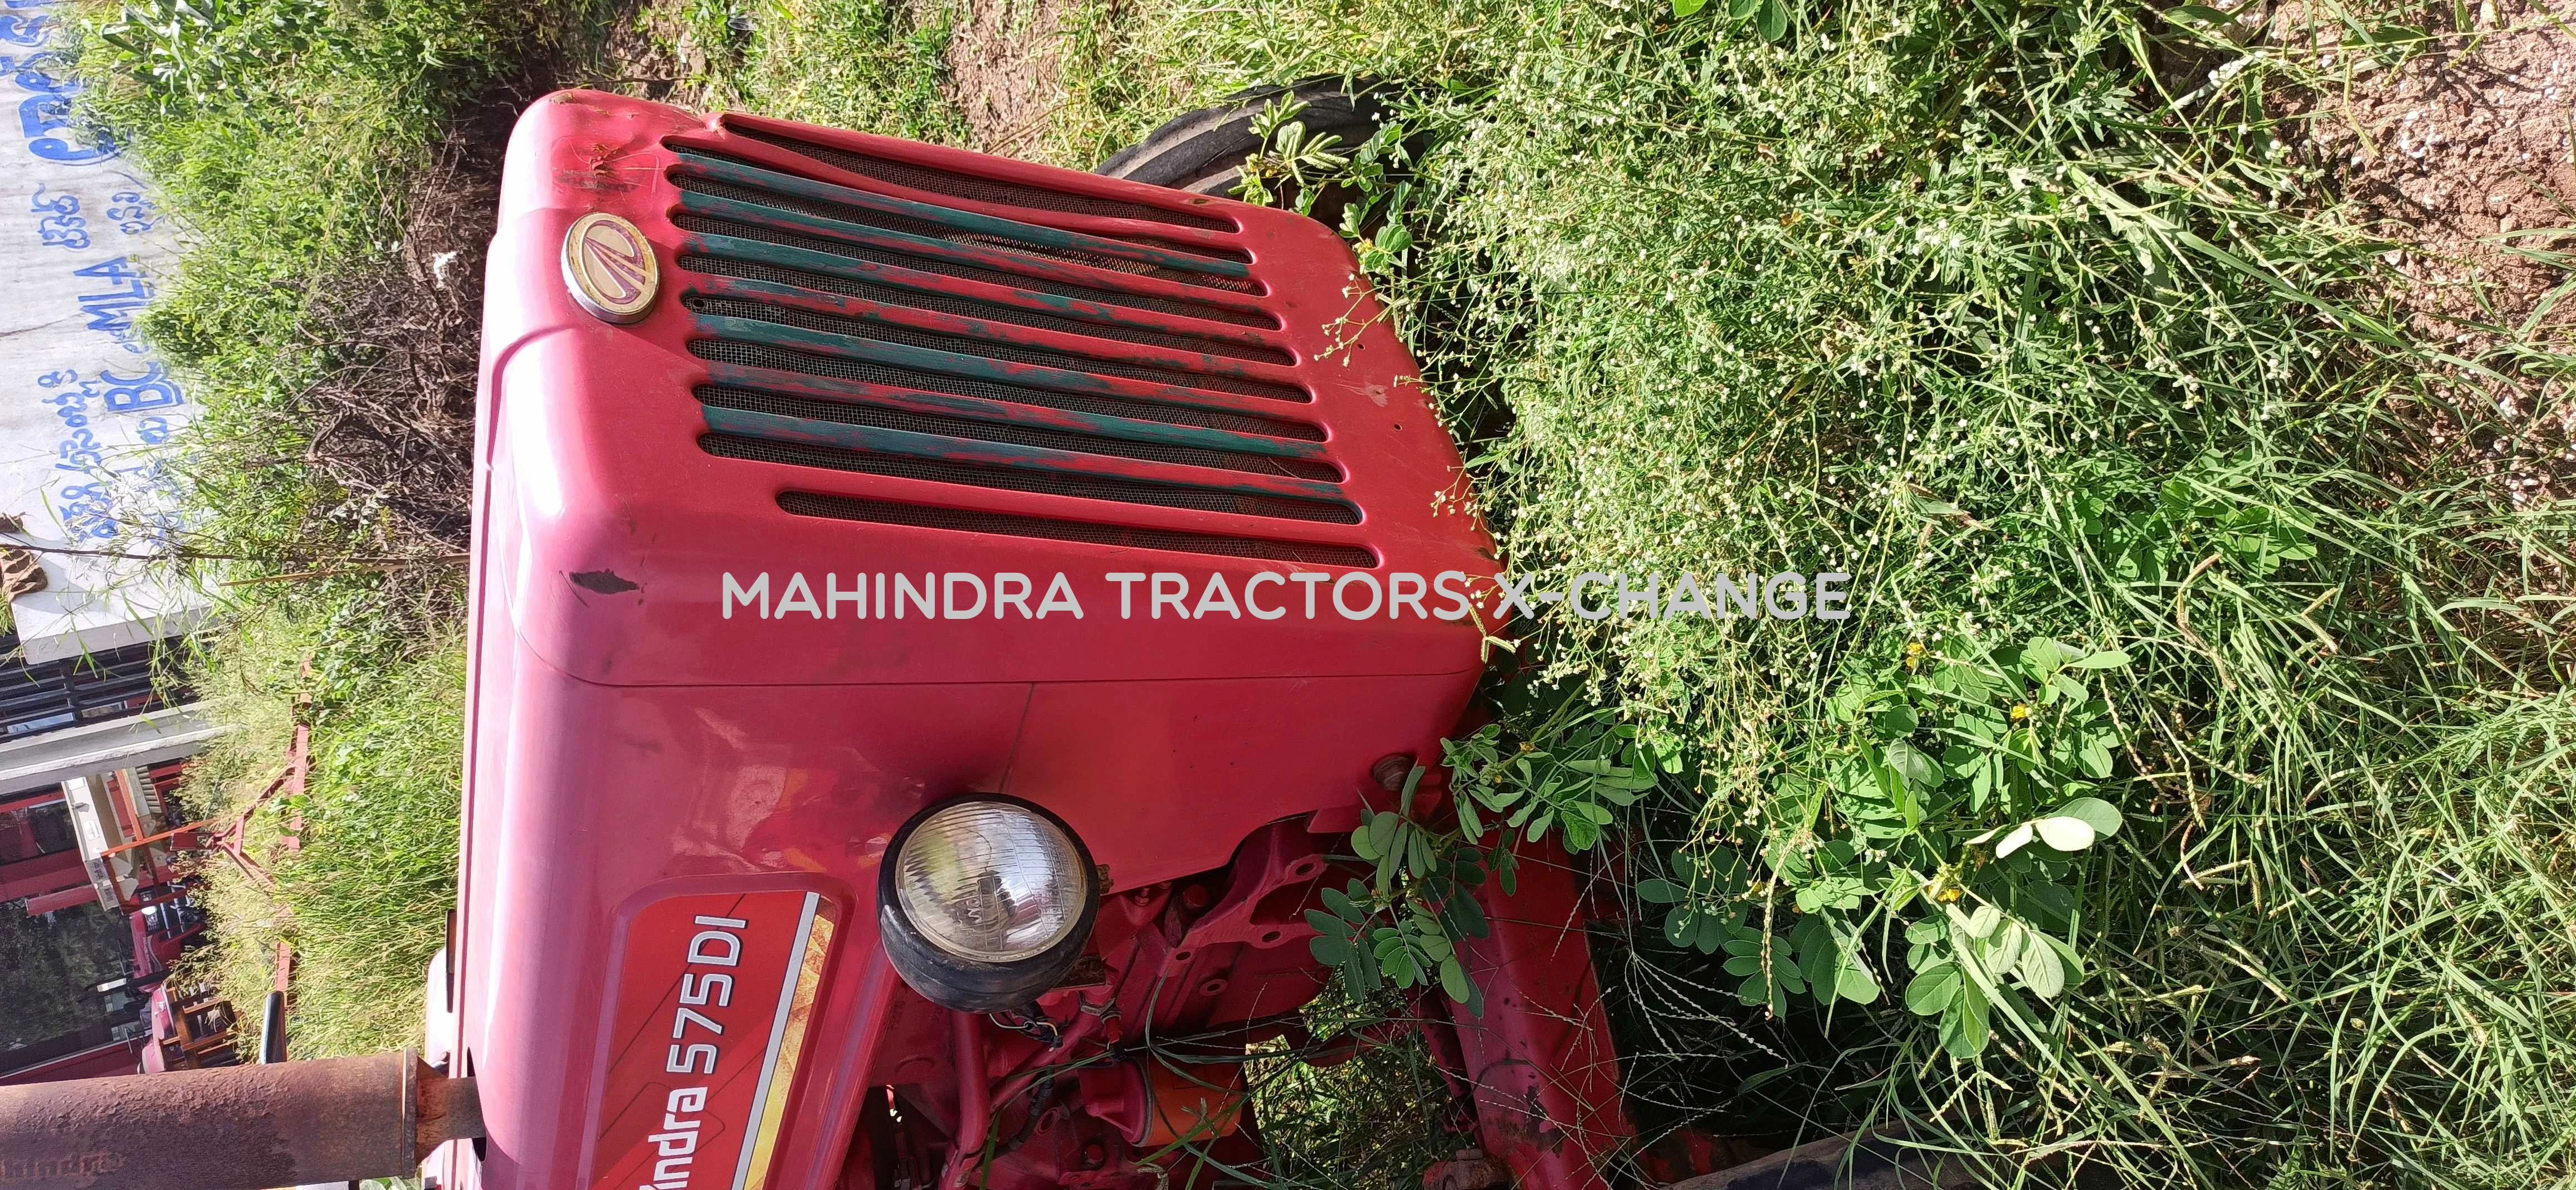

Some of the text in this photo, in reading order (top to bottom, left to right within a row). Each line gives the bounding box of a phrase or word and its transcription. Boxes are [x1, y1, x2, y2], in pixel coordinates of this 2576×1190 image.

[73, 257, 153, 330] MLA
[100, 362, 183, 412] BC
[666, 915, 747, 1075] 575DI
